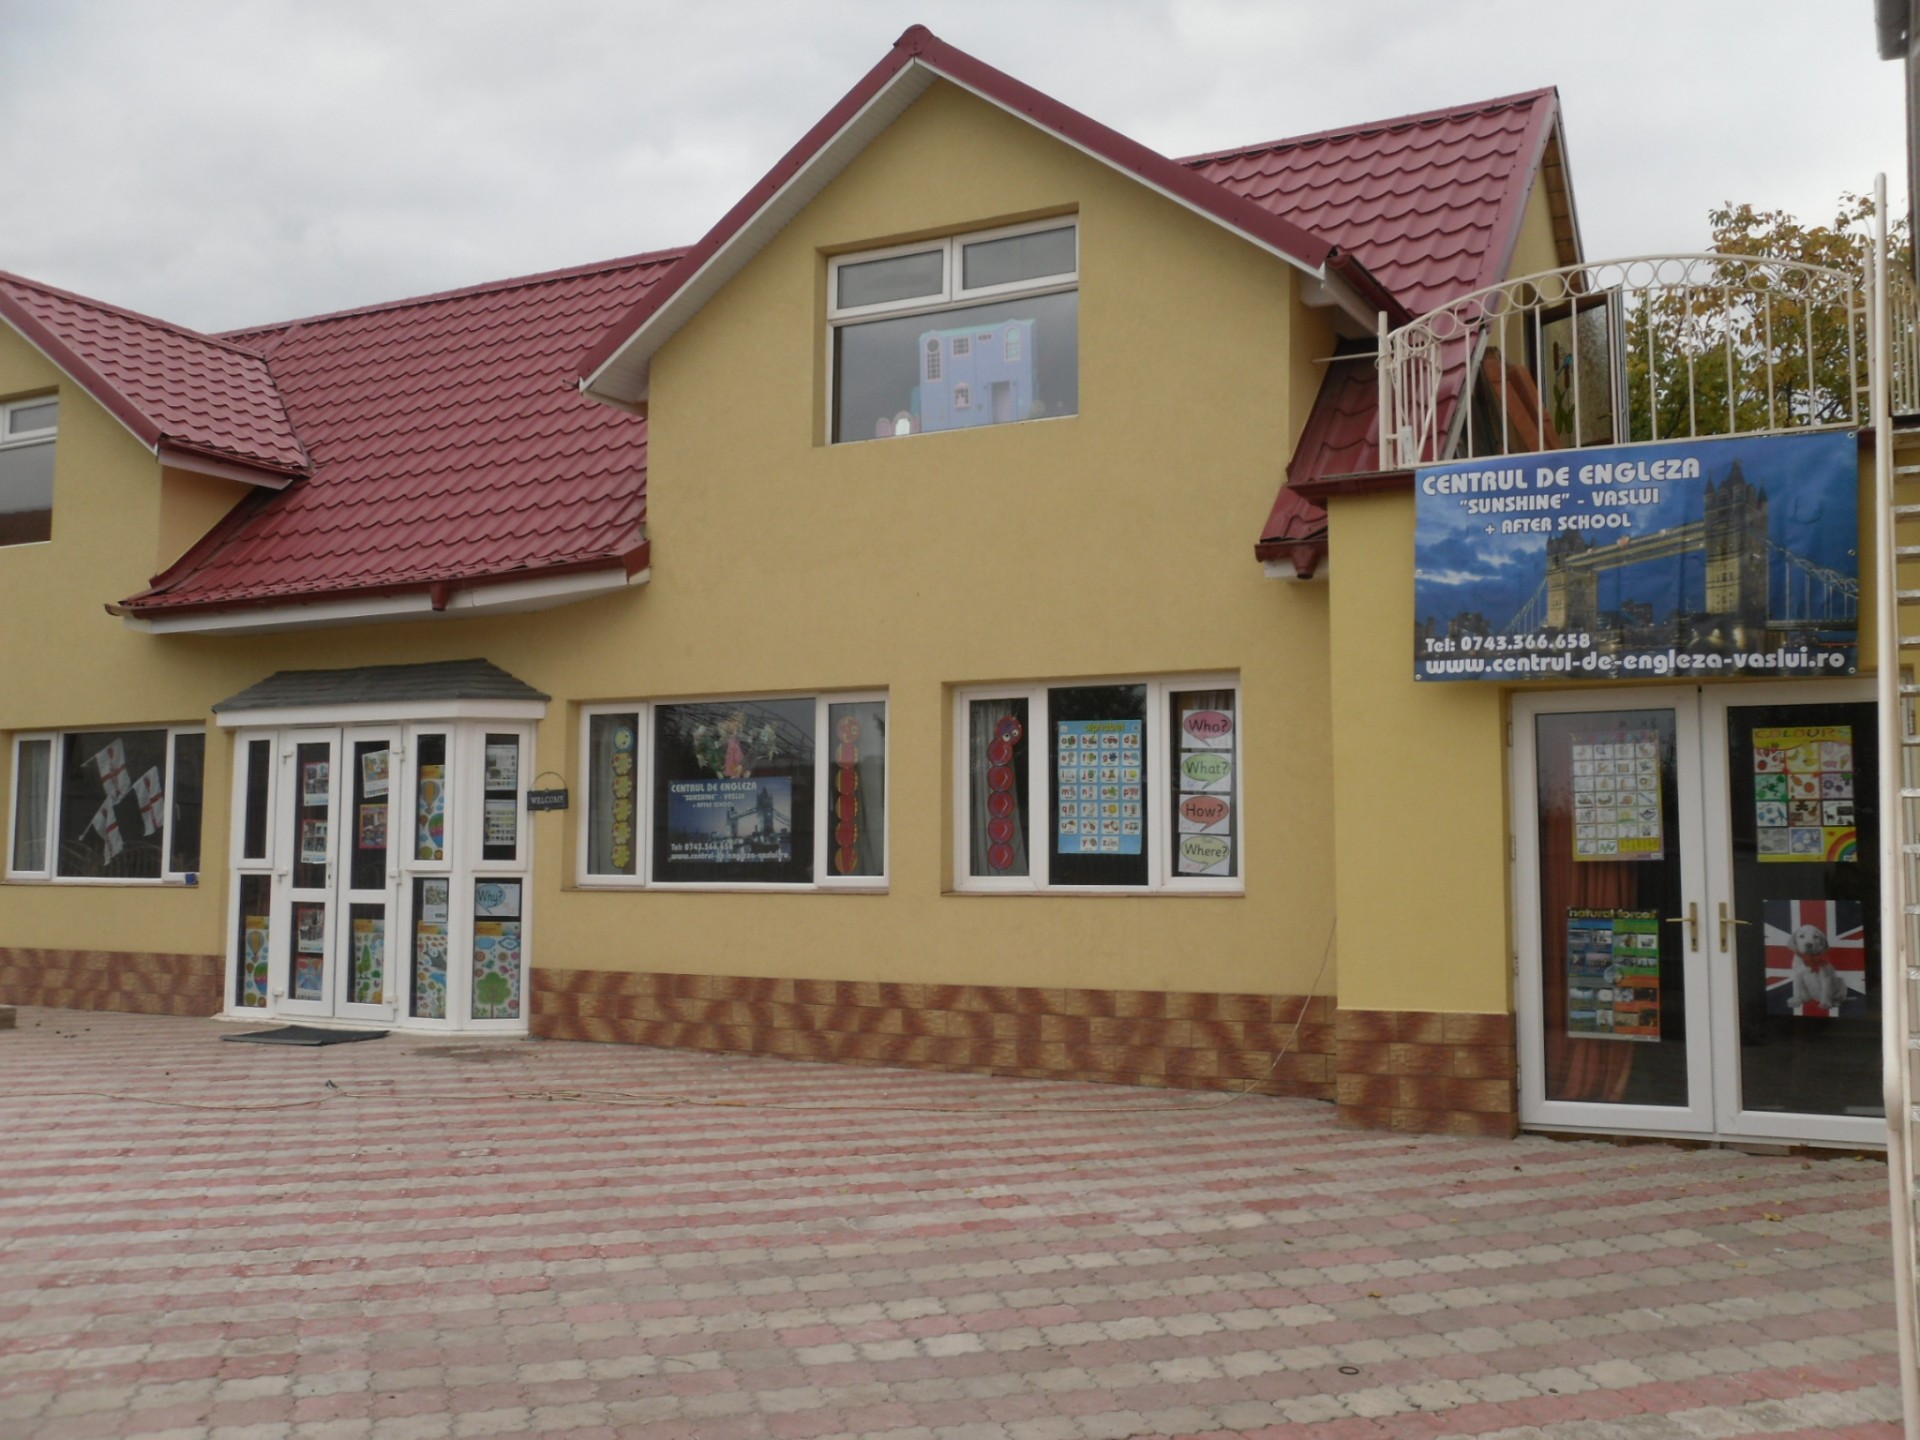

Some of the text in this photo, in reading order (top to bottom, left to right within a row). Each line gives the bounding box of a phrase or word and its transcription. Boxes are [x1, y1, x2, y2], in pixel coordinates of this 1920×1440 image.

[1422, 457, 1700, 496] CENTRUL DE ENGLEZA
[1459, 493, 1570, 515] "SUNSHINE"
[1592, 487, 1660, 507] VASLUI
[1502, 516, 1552, 535] AFTER
[1557, 513, 1632, 532] SCHOOL
[1425, 633, 1591, 653] Tel: 0743.366.658
[1425, 646, 1846, 676] www.centrul-de-engleza-vaslui.ro
[1188, 719, 1228, 733] Who?
[1755, 727, 1850, 739] COLOURS
[1185, 761, 1228, 775] What?
[671, 781, 757, 793] CENTRUL DE ENGLEZA
[530, 795, 564, 804] WELCOME
[1185, 803, 1224, 817] How?
[1184, 843, 1228, 858] Where?
[478, 890, 503, 907] Why?
[1568, 909, 1615, 918] natural
